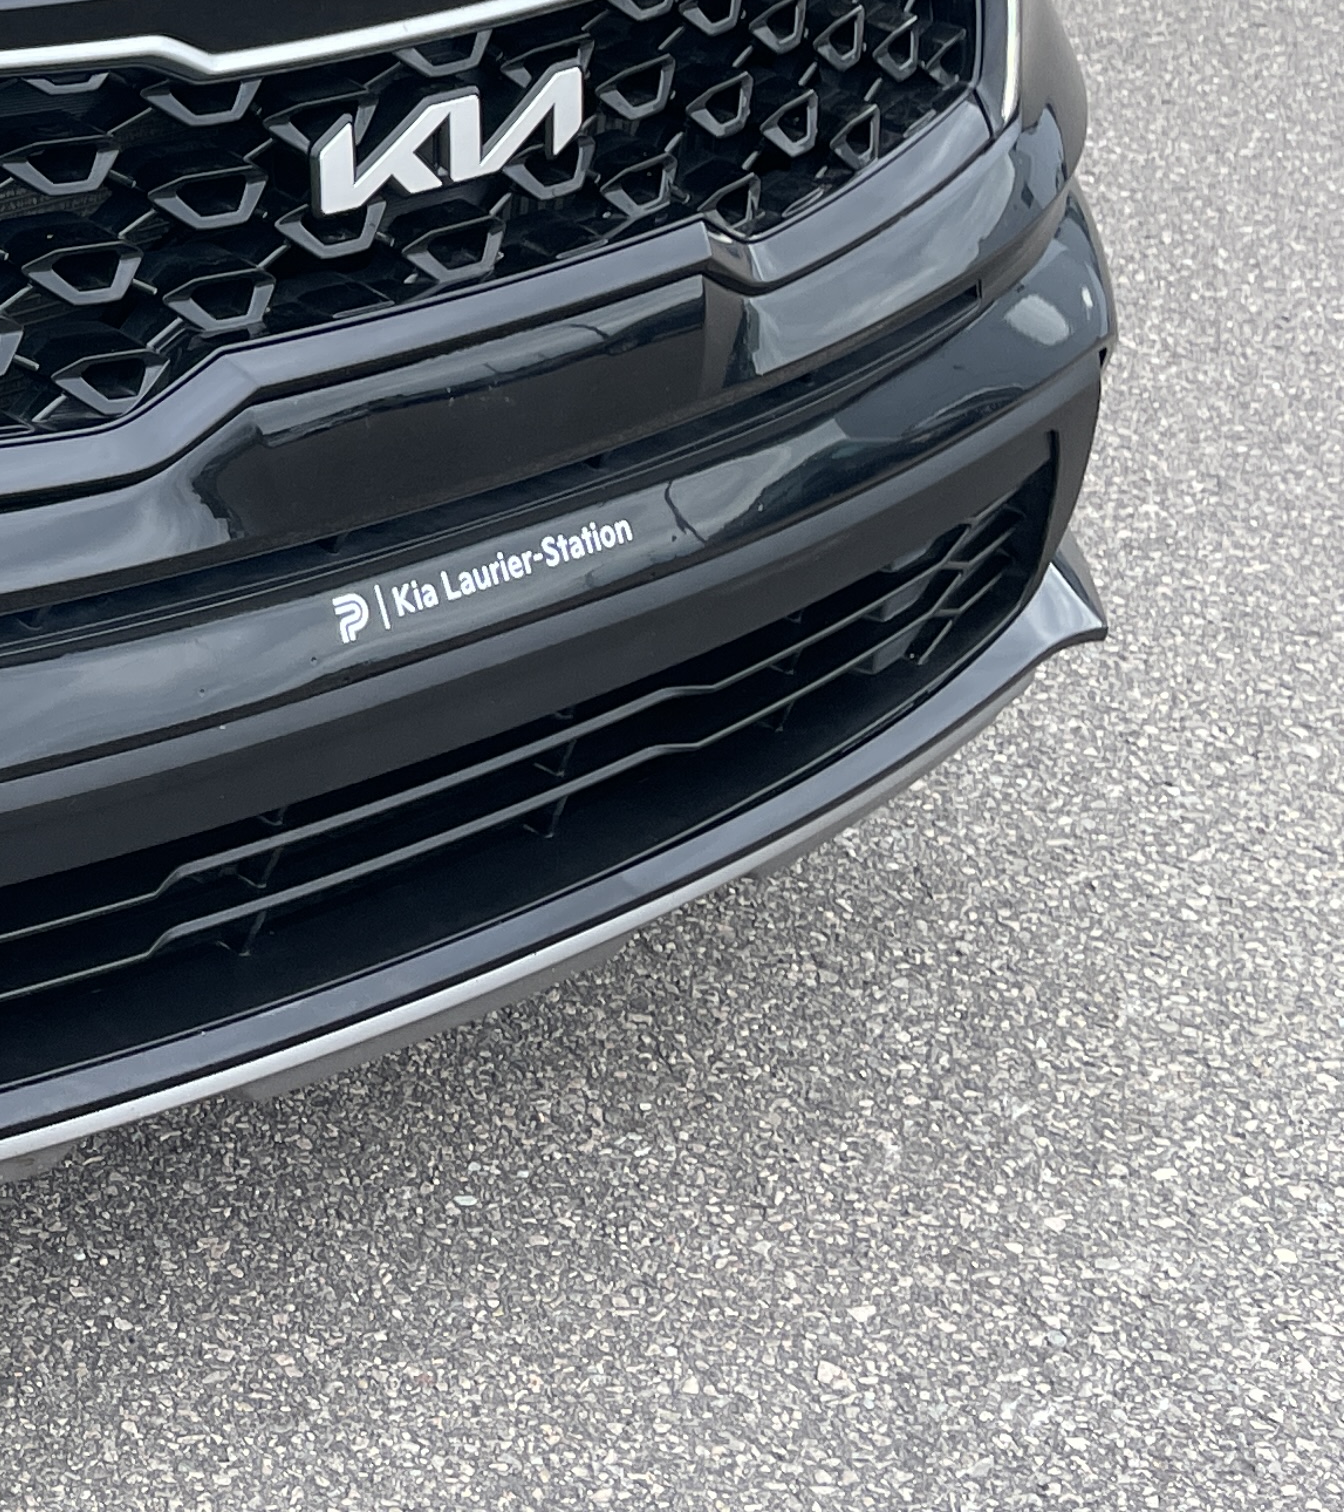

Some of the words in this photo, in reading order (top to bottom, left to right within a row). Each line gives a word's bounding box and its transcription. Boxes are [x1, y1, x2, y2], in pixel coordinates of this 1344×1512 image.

[317, 64, 583, 216] KIA
[391, 579, 439, 617] Kia
[440, 519, 633, 601] Laurier-Station
